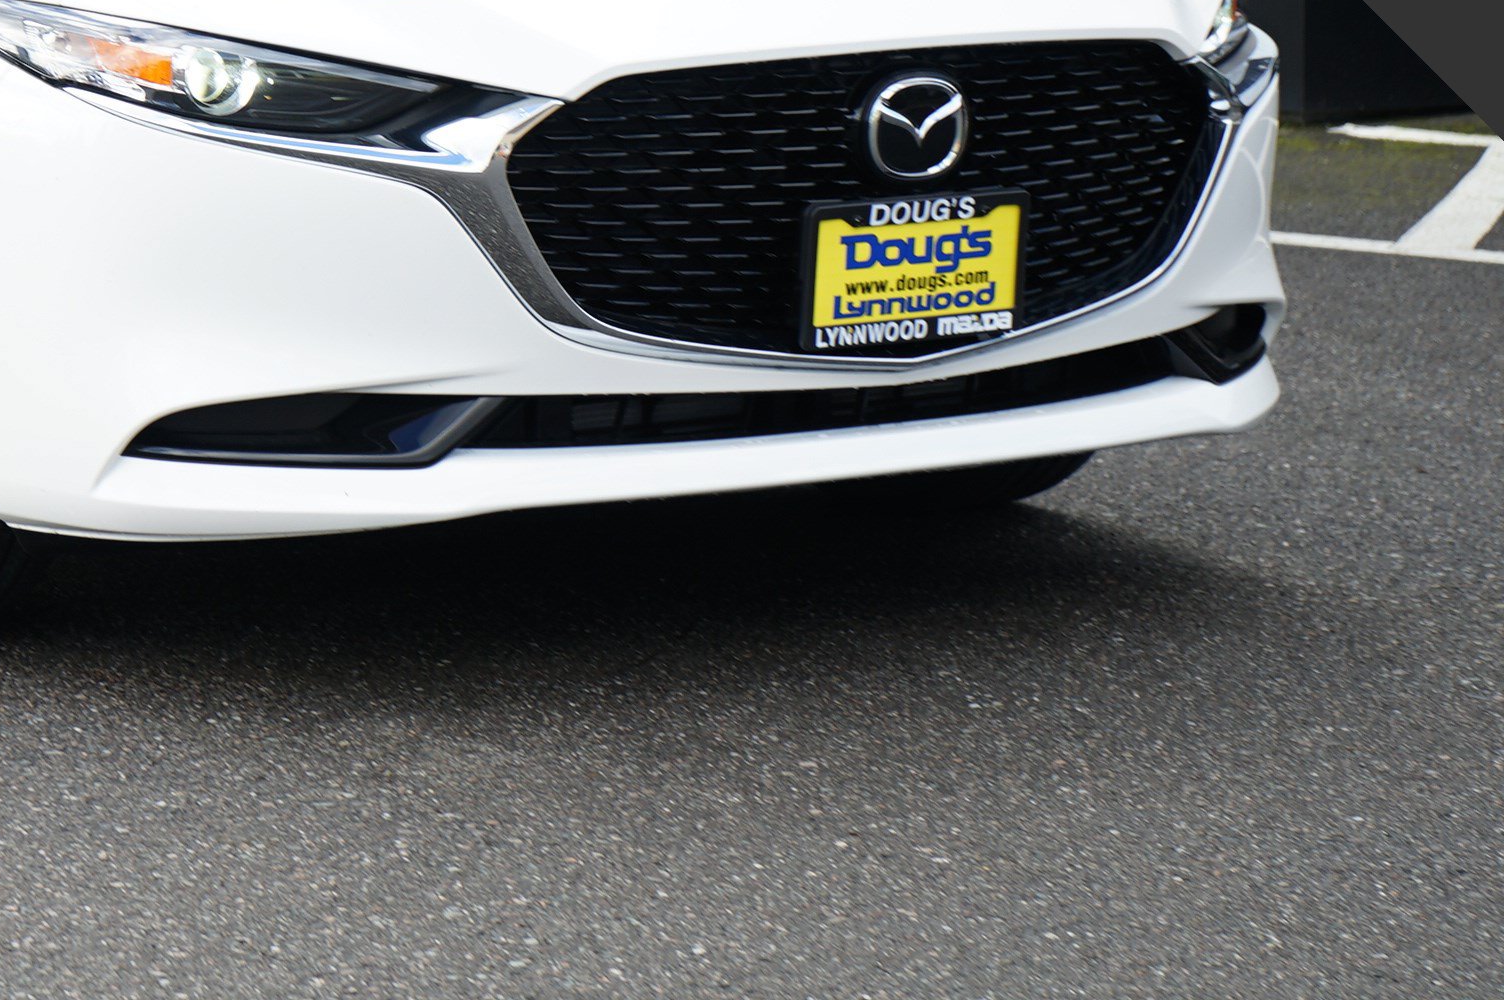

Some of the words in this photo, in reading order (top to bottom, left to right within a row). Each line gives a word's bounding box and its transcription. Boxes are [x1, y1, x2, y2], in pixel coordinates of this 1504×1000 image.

[869, 196, 976, 226] DOUG'S
[841, 225, 992, 273] Doug's
[845, 270, 990, 296] www.dougs.com
[833, 281, 996, 319] Lynnwood
[815, 319, 928, 348] LYNNWOOD
